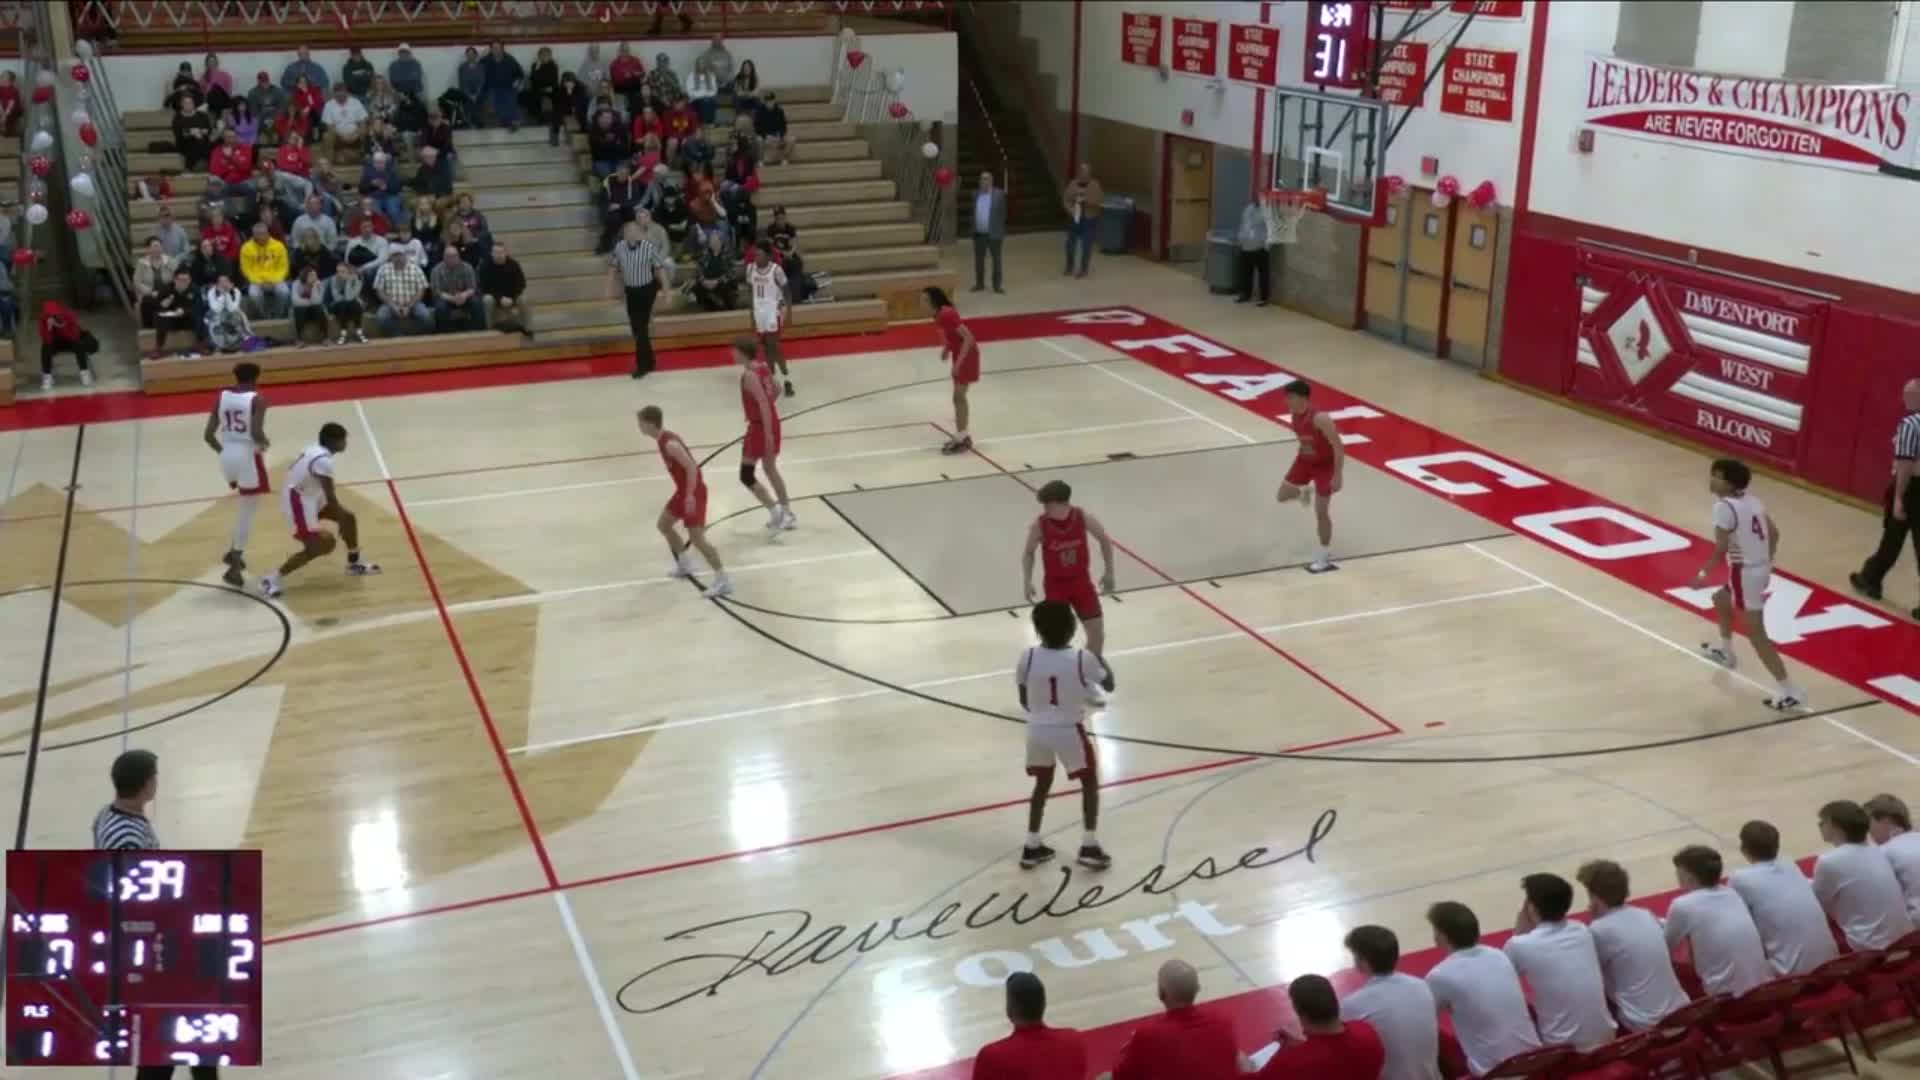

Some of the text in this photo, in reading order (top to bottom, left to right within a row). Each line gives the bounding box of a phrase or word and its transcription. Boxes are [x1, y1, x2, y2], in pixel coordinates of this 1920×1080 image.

[1313, 33, 1346, 78] 31
[1464, 52, 1496, 68] STATE
[1452, 67, 1506, 88] CHAMPIONS
[1587, 61, 1910, 150] LEADERS & CHAMPIONS
[1643, 114, 1822, 155] ARE NEVER FORGOTTEN
[1684, 290, 1799, 336] DAVENPORT
[1720, 358, 1774, 390] WEST
[223, 410, 247, 433] 15
[1696, 409, 1772, 448] FALCONS
[1752, 515, 1765, 541] 4
[1049, 676, 1059, 706] 1
[616, 809, 1338, 1015] Dave Wessel
